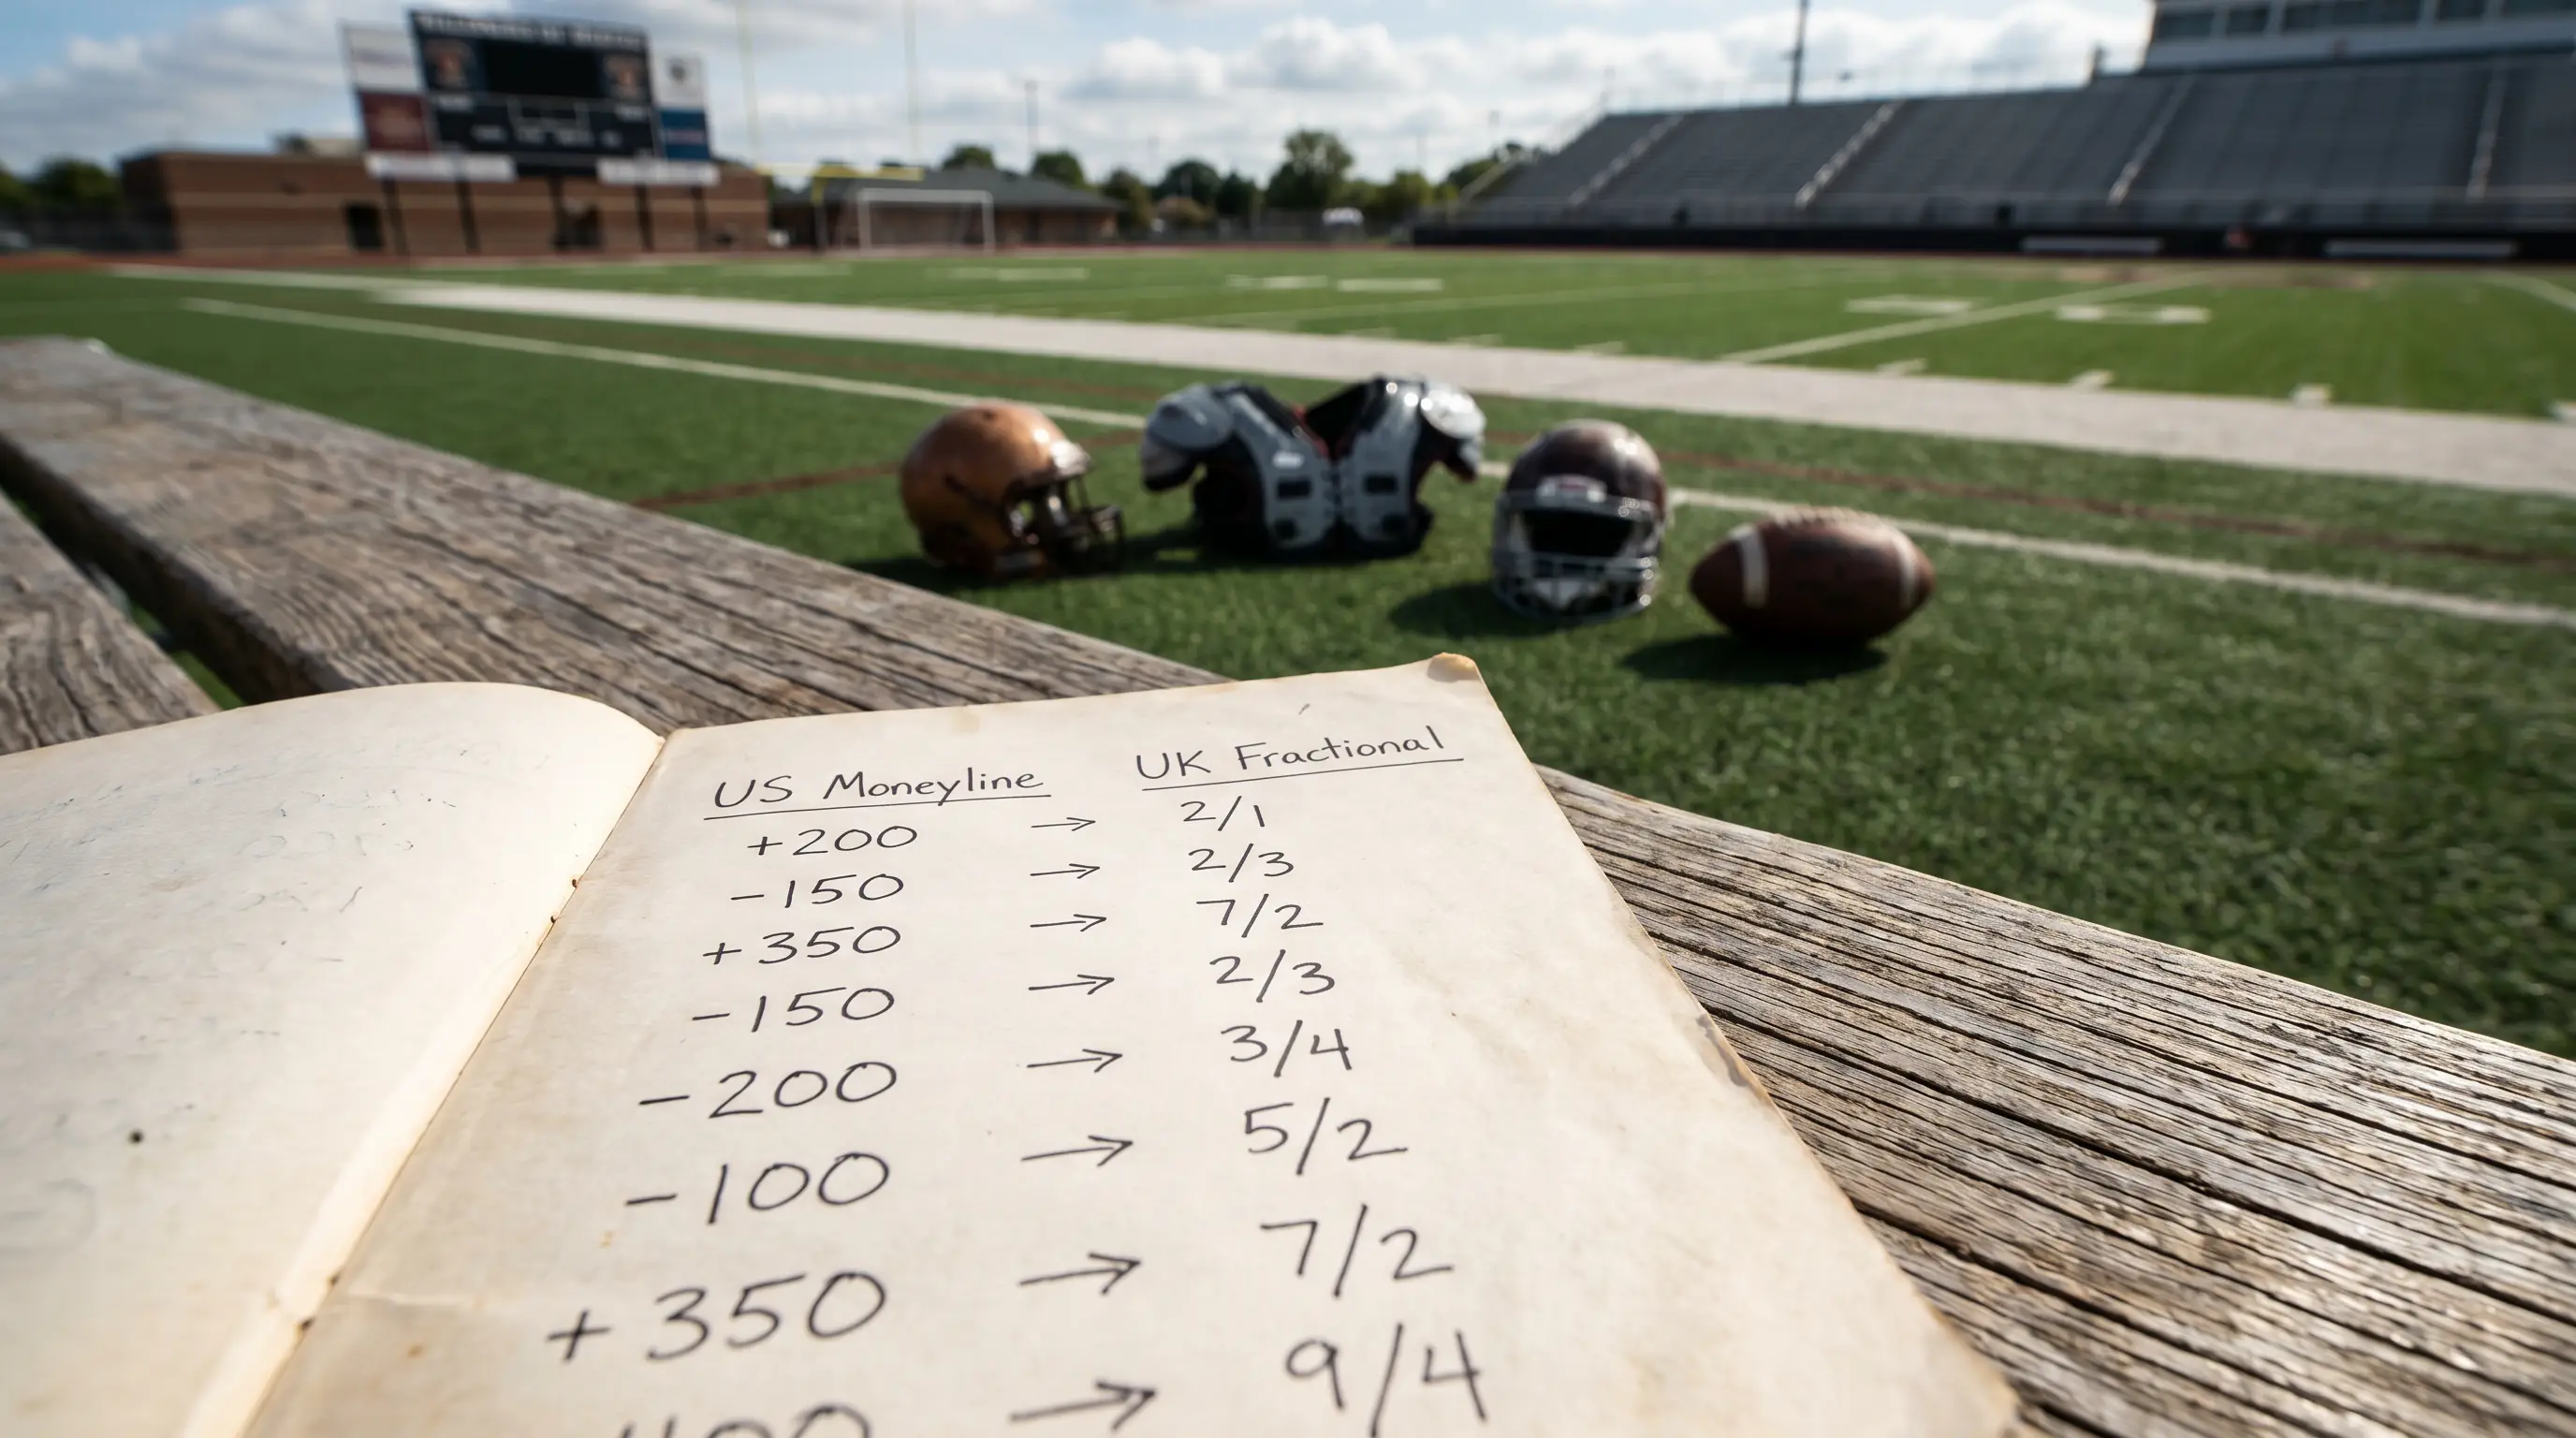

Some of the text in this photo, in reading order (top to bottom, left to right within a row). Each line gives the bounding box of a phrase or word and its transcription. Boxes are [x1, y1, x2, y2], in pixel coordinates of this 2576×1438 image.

[1134, 724, 1445, 781] UK Fractional
[713, 766, 1045, 810] US Moneyline
[1178, 794, 1266, 833] 2/1
[746, 824, 919, 858] +200
[1187, 842, 1295, 885] 2/3
[1194, 892, 1325, 940] 7/2
[701, 924, 902, 968] +350
[1208, 947, 1337, 1005] 2/3
[1219, 1018, 1354, 1079] 3/4
[1242, 1095, 1410, 1178] 5/2
[1258, 1201, 1456, 1301] 7/2
[1282, 1321, 1488, 1438] 9/4
